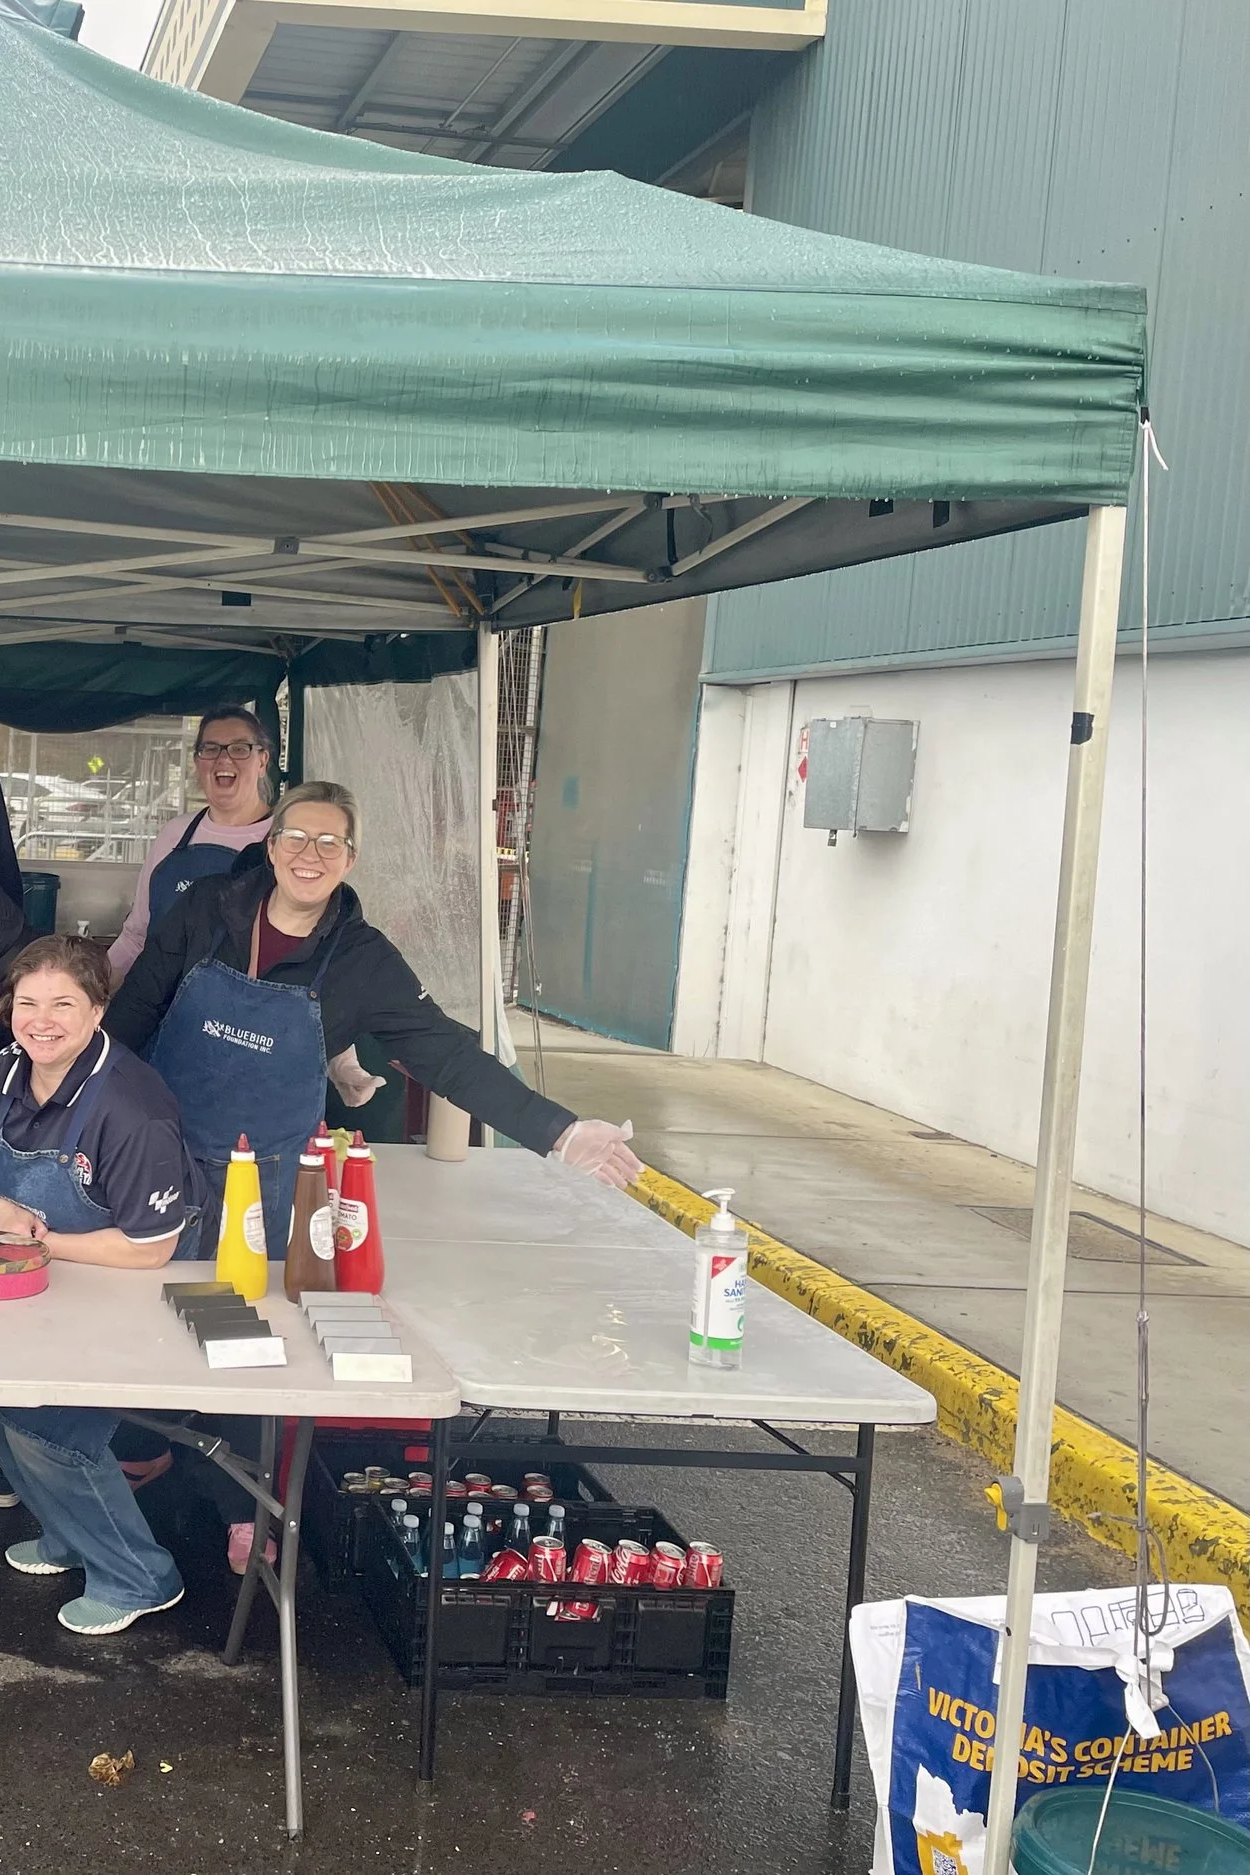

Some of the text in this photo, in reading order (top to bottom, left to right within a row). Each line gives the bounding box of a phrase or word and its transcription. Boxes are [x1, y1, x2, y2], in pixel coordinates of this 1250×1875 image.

[223, 1034, 258, 1050] FOUNDATION
[225, 1025, 274, 1047] BLUEBIRD
[928, 1687, 1232, 1763] VICTOIA'S CONTAINER
[1076, 1749, 1193, 1778] SCHEME
